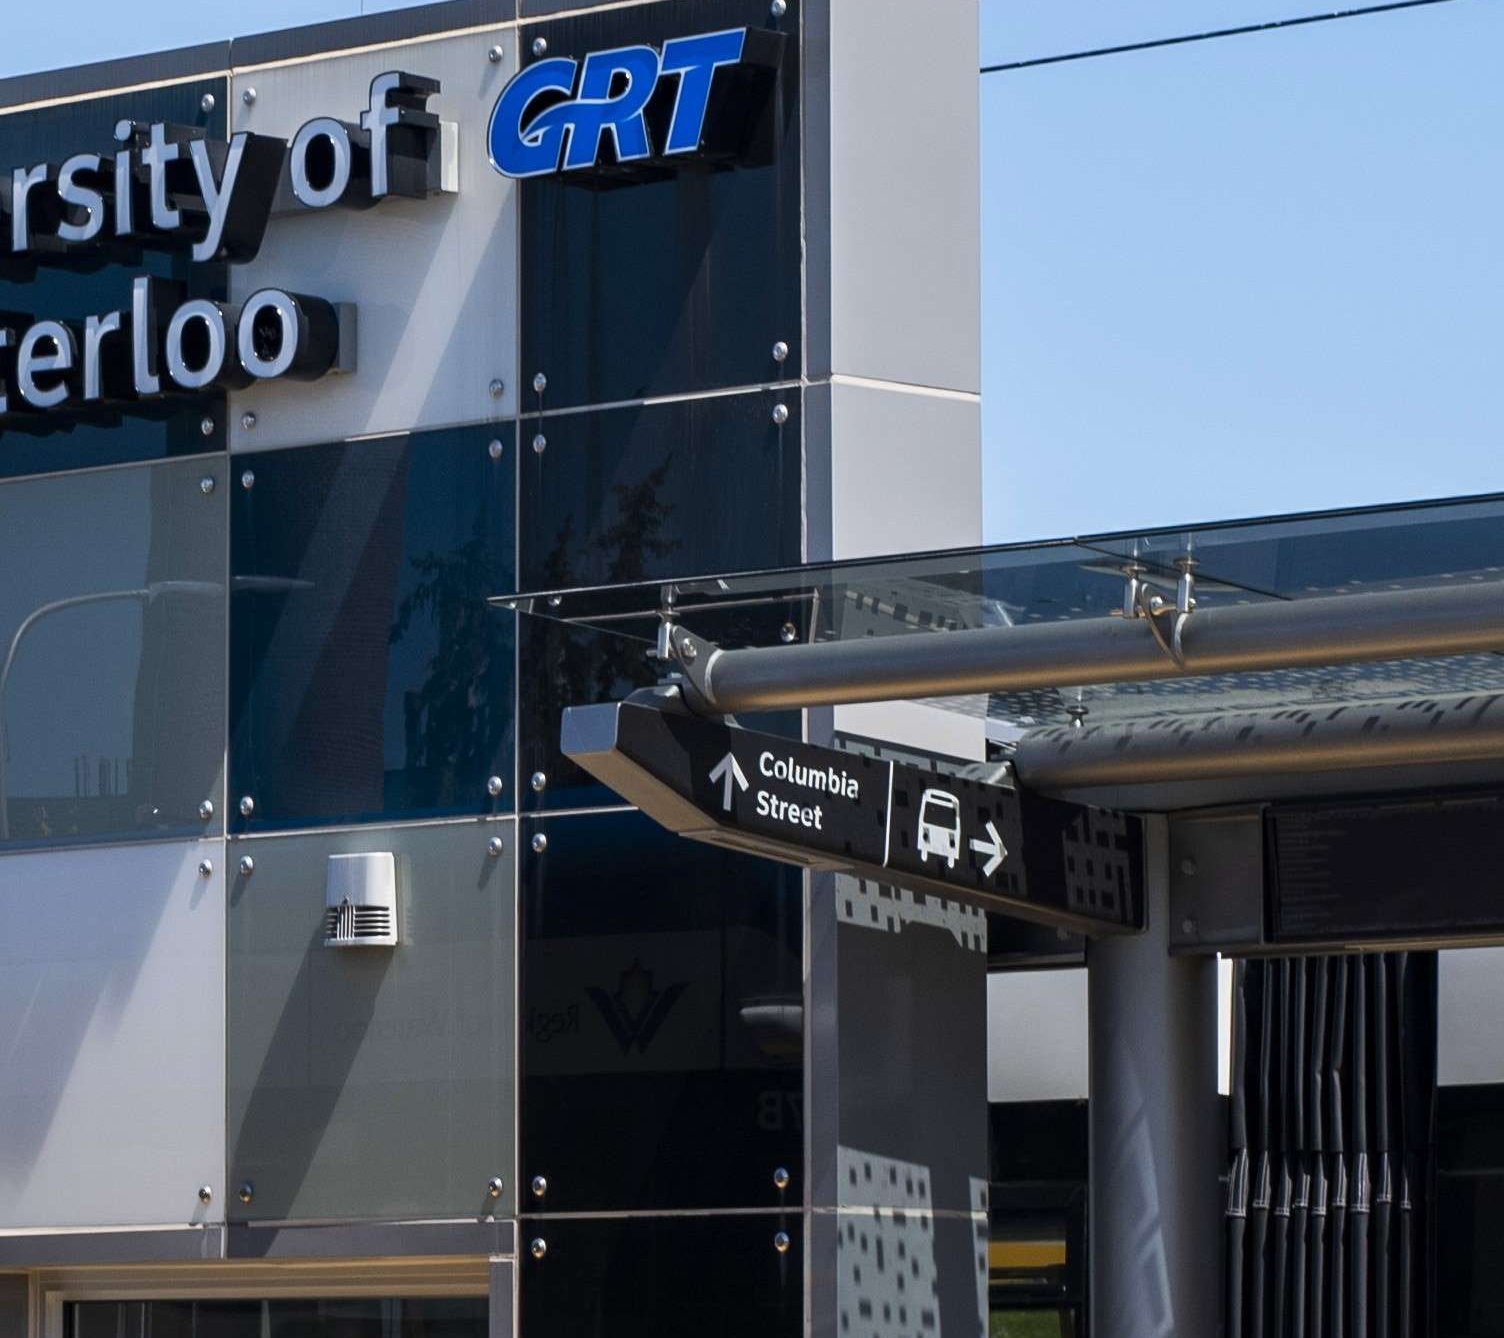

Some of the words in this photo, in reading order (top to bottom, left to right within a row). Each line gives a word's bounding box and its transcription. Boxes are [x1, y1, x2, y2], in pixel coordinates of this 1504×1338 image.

[291, 70, 441, 209] of
[488, 26, 748, 179] GRT
[756, 790, 823, 830] Street
[759, 751, 859, 799] Columbia
